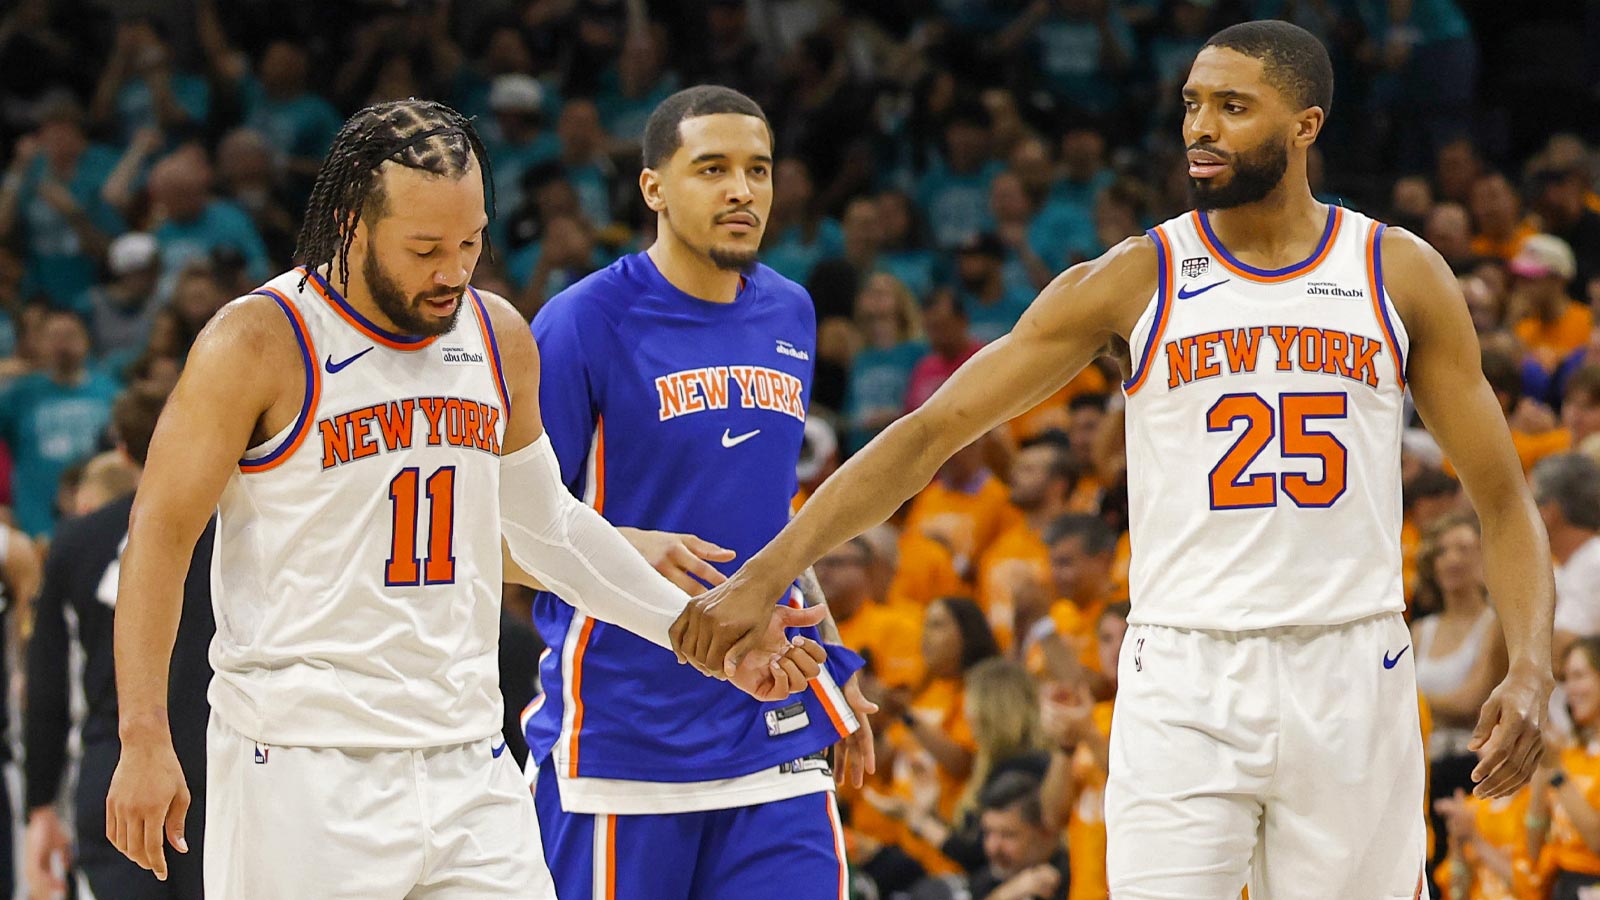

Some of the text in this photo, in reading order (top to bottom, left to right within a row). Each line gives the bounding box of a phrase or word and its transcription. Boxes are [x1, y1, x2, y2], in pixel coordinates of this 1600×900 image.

[1307, 286, 1363, 297] abu dhabi
[443, 352, 483, 362] abu dhabi
[1165, 325, 1382, 391] NEW YORK
[655, 365, 805, 423] NEW YORK
[317, 397, 501, 471] NEW YORK
[1206, 392, 1347, 510] 25
[384, 465, 456, 587] 11
